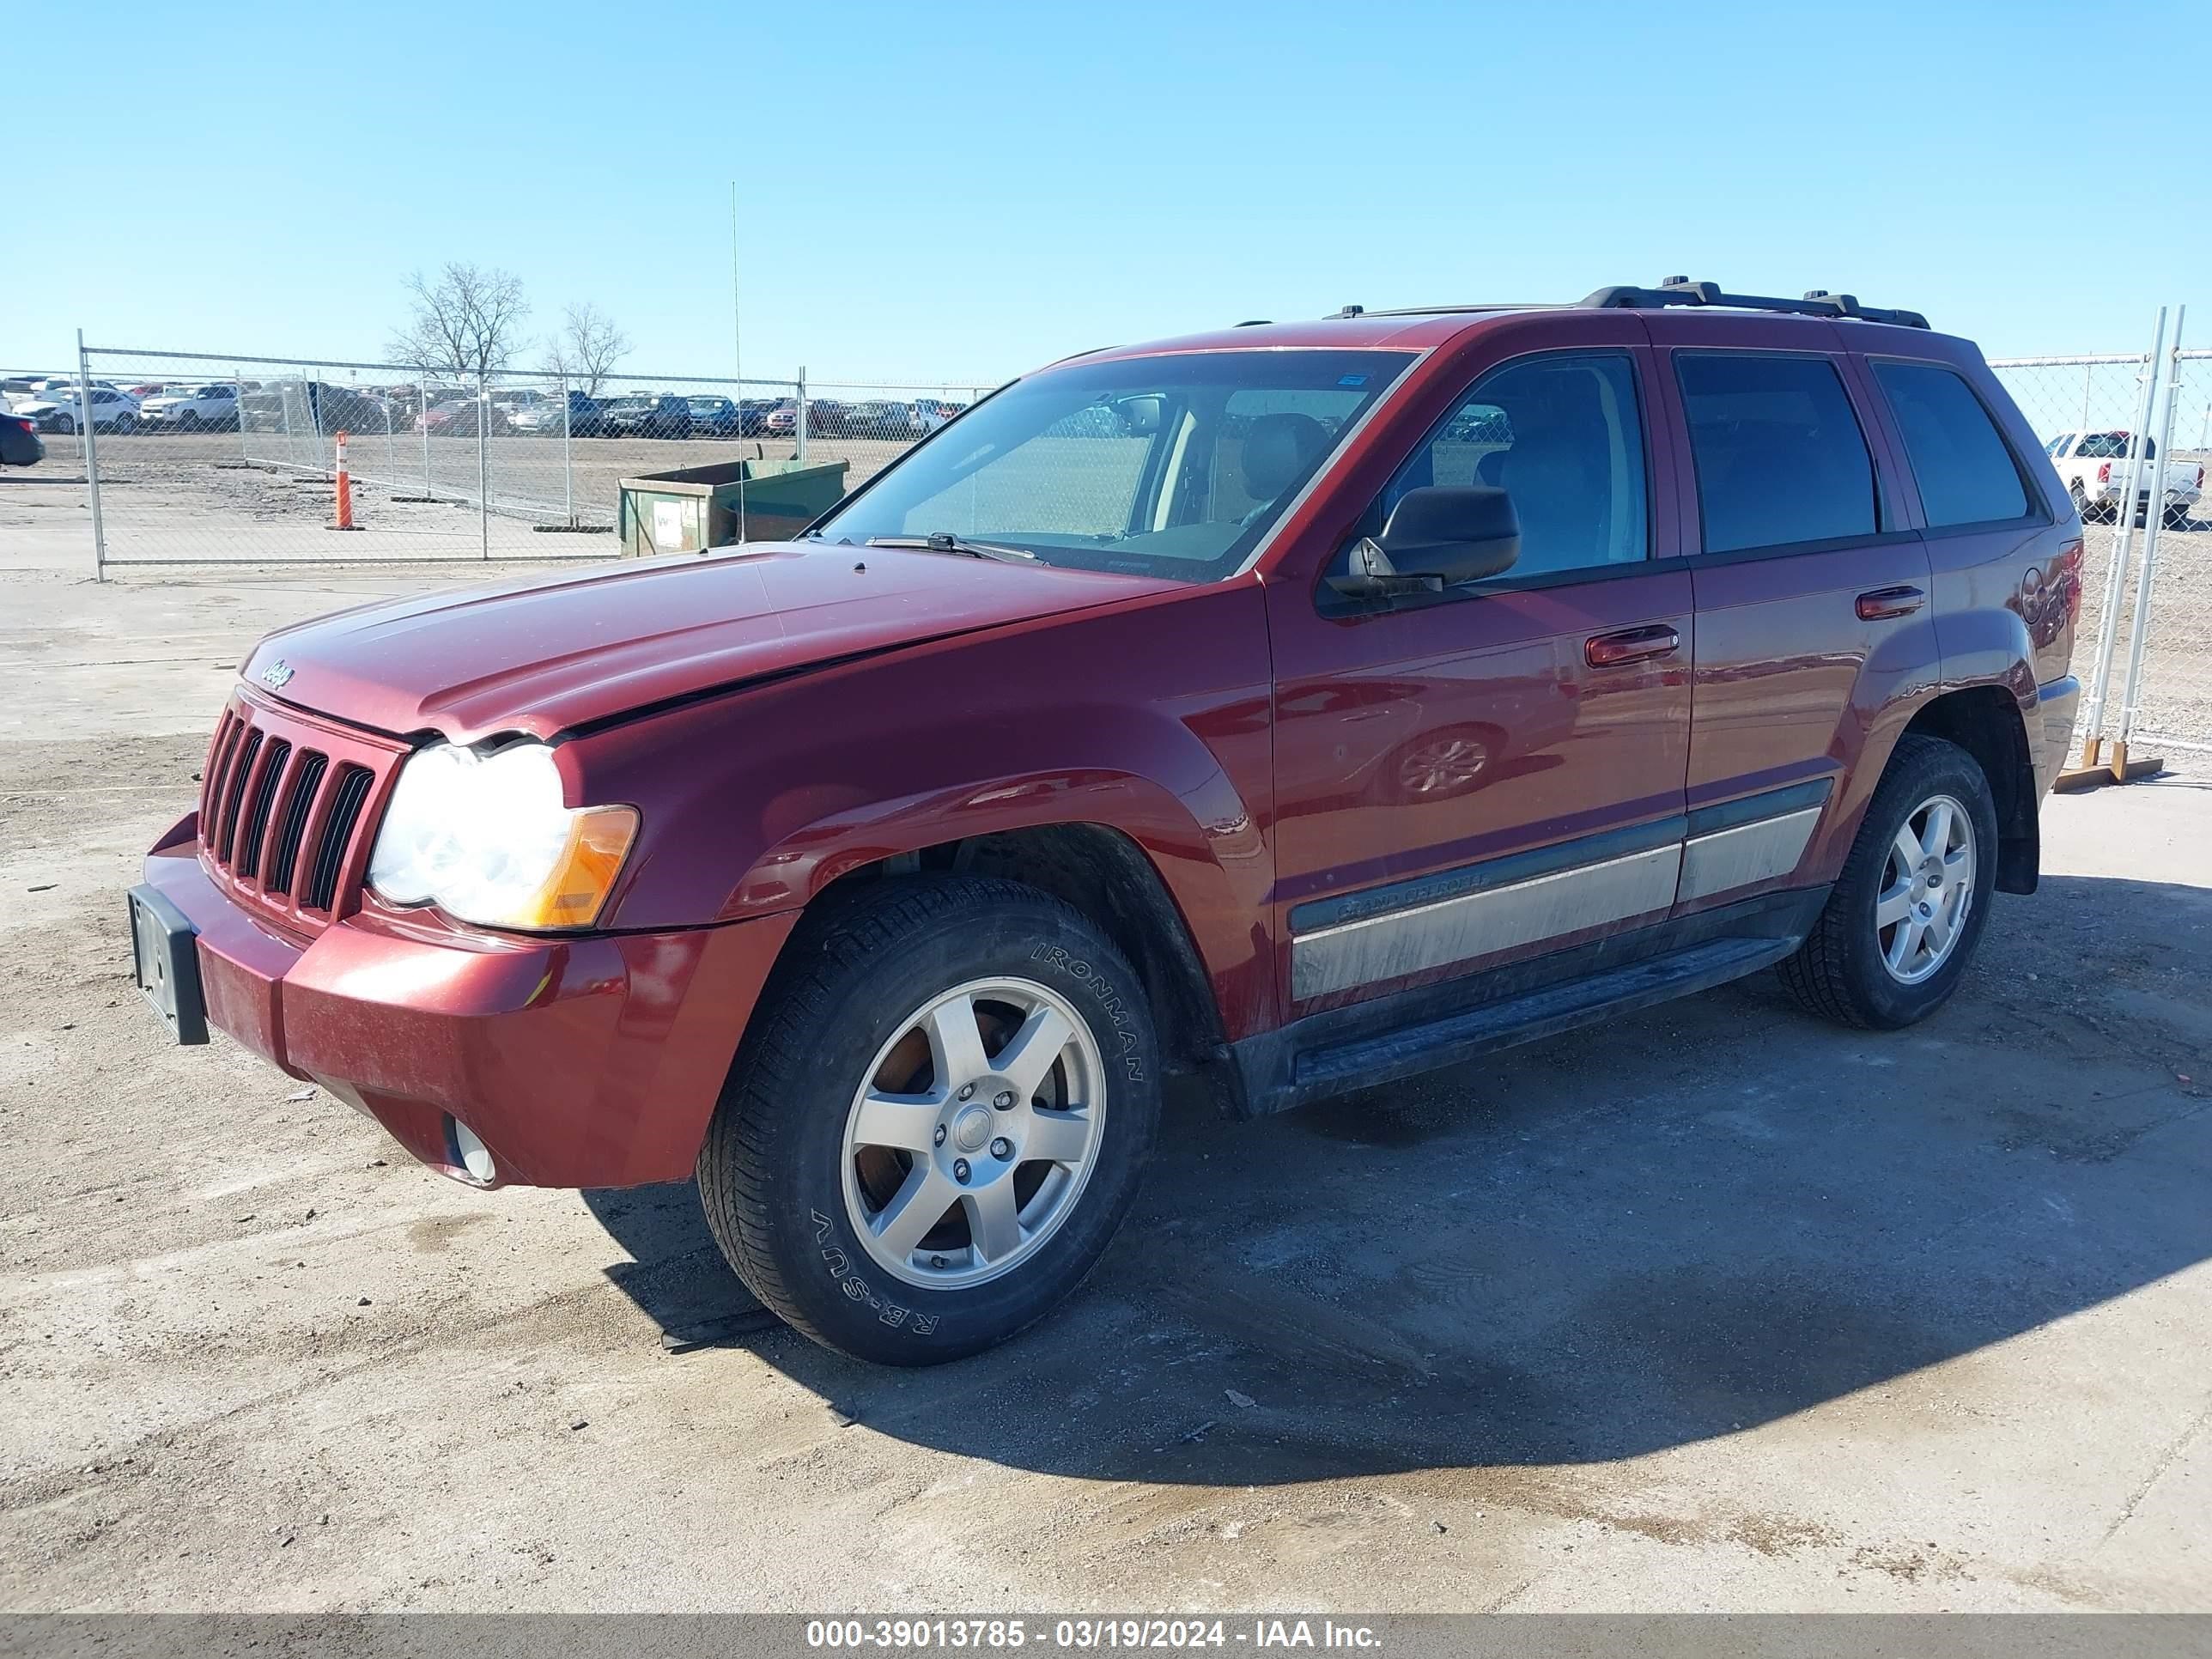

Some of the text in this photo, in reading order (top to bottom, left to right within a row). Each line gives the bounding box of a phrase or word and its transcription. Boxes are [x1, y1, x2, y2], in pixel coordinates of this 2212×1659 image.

[261, 659, 295, 691] Jeep
[1337, 872, 1491, 918] GRAND CHEROKEE
[1030, 943, 1144, 1082] IRONMAN
